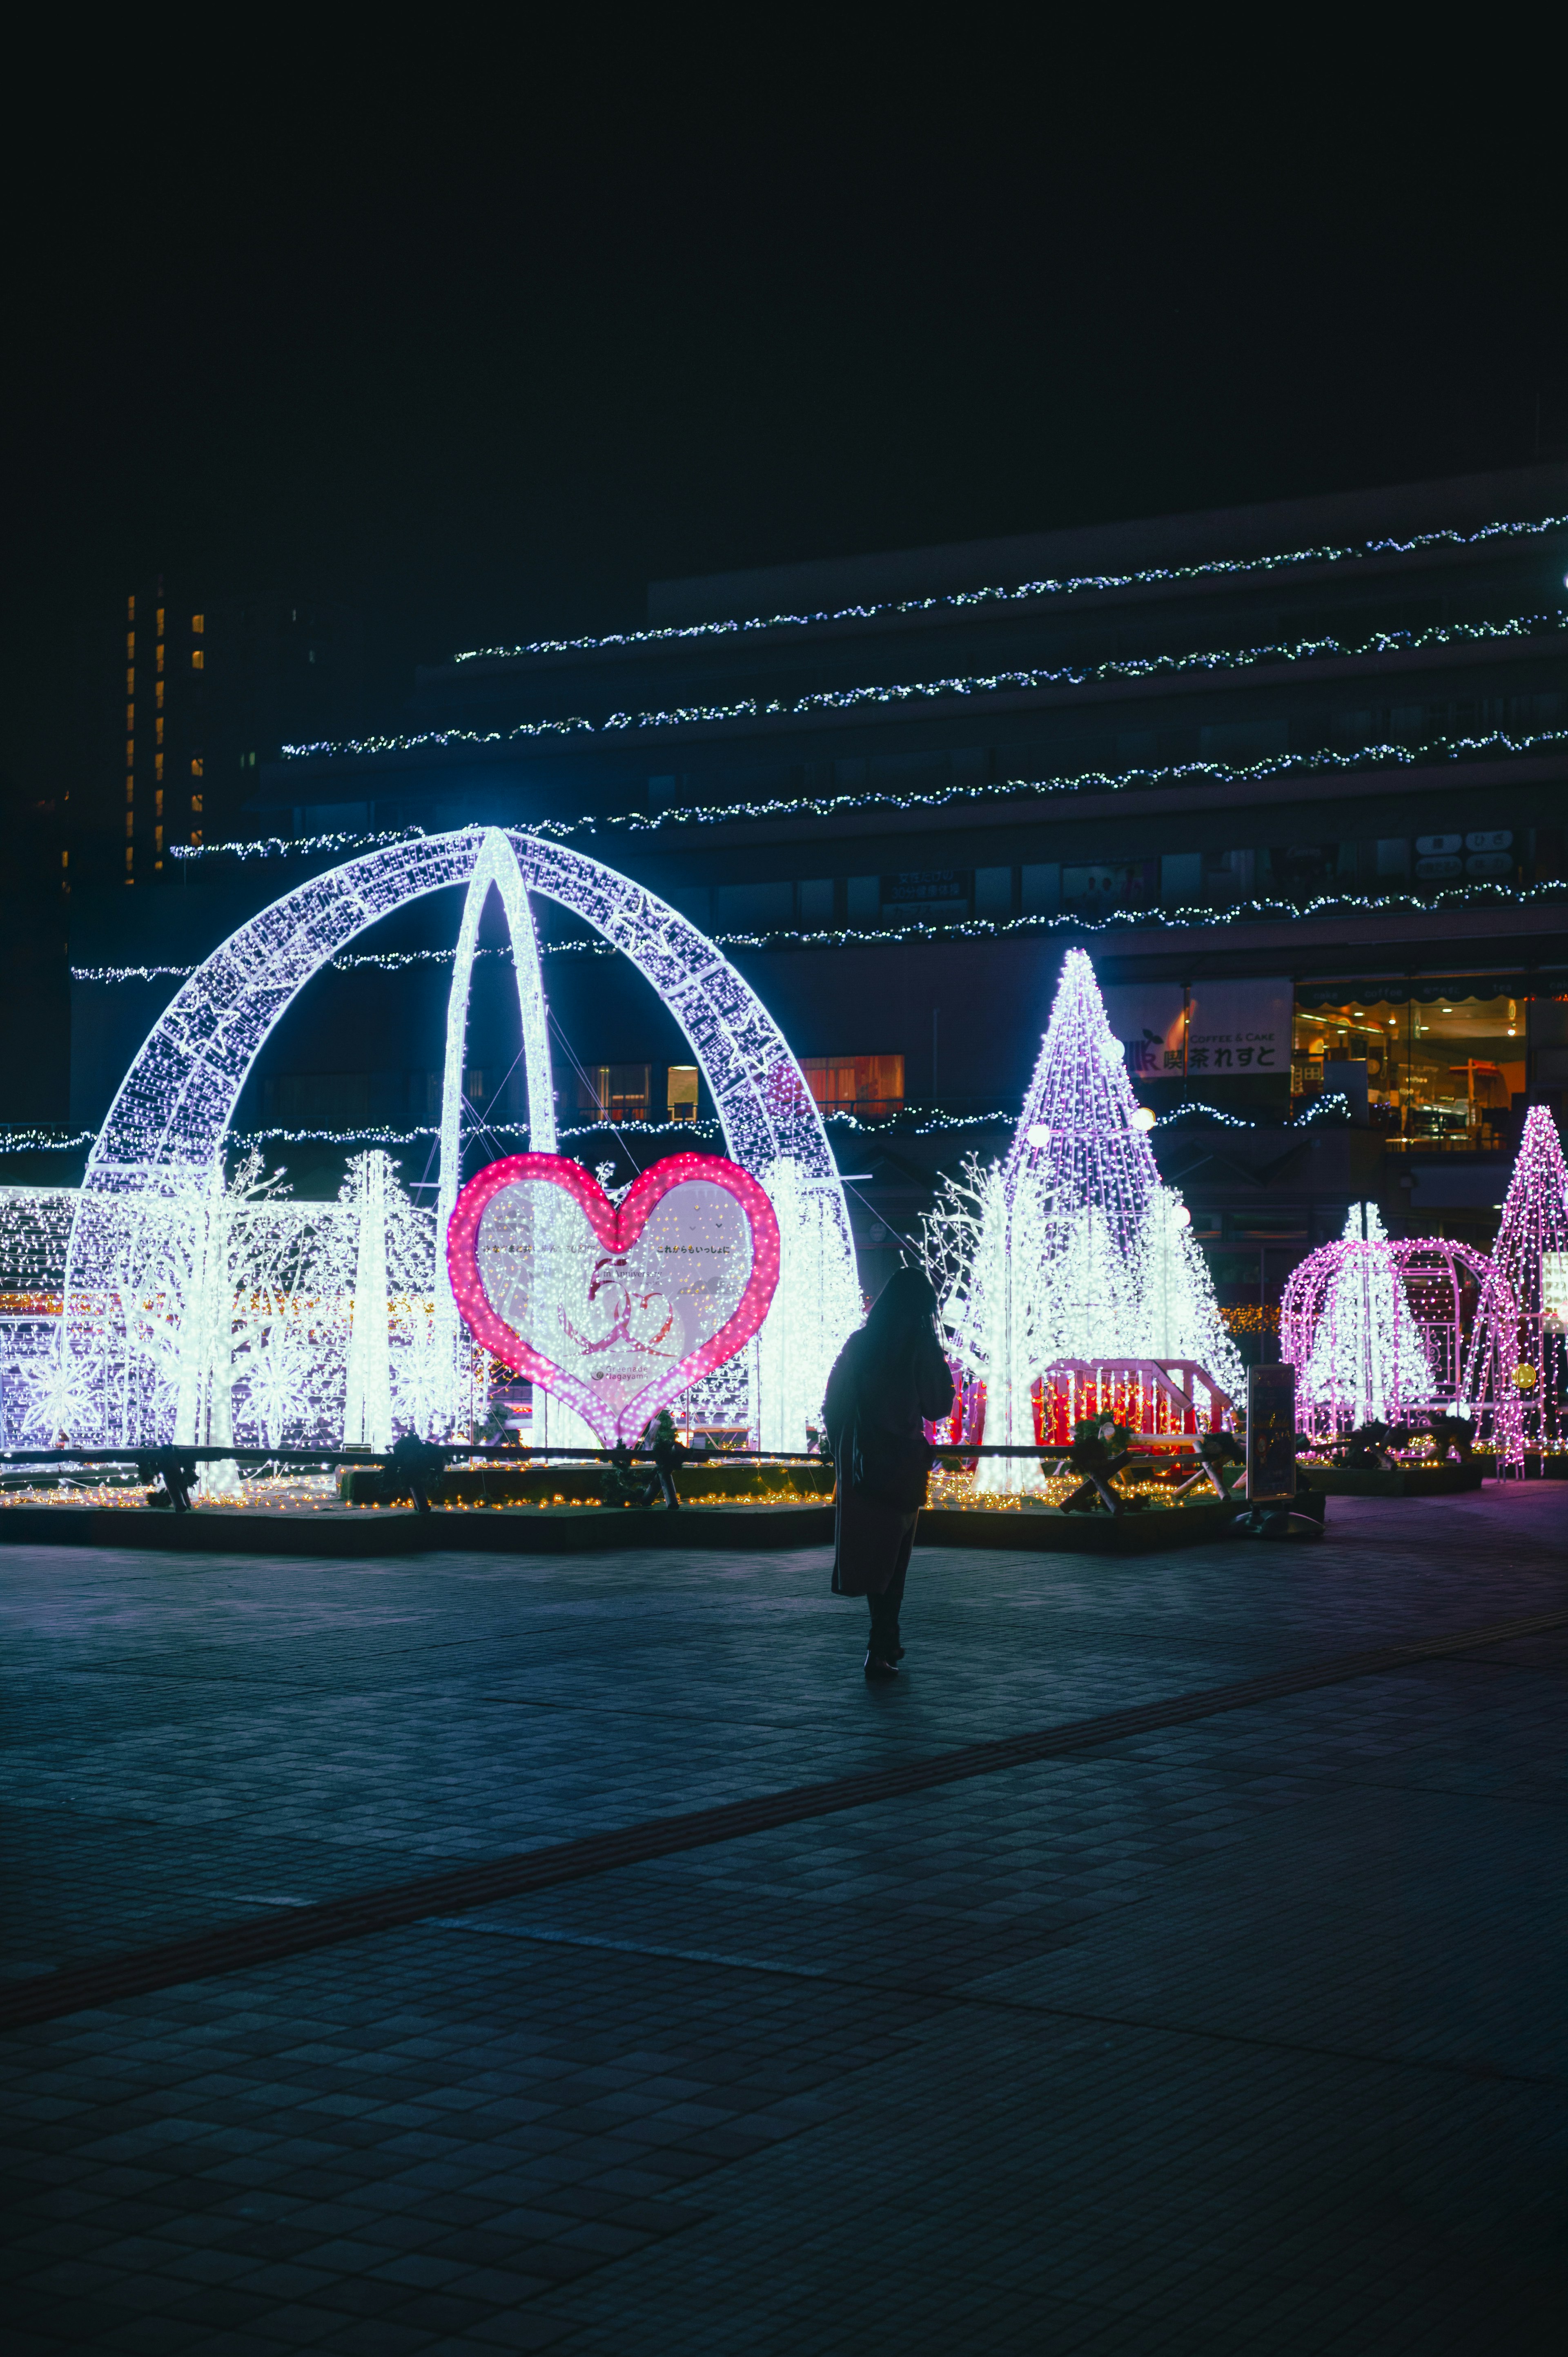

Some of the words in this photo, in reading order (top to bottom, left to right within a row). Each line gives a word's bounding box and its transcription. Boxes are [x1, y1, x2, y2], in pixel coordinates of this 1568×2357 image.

[1364, 987, 1403, 998] coffee
[1236, 1033, 1243, 1041] &
[1164, 1046, 1276, 1070] 喫茶れすと
[657, 1245, 730, 1254] これからもいっしょに
[613, 1269, 663, 1280] Anniversary
[606, 1373, 648, 1381] Nagayama
